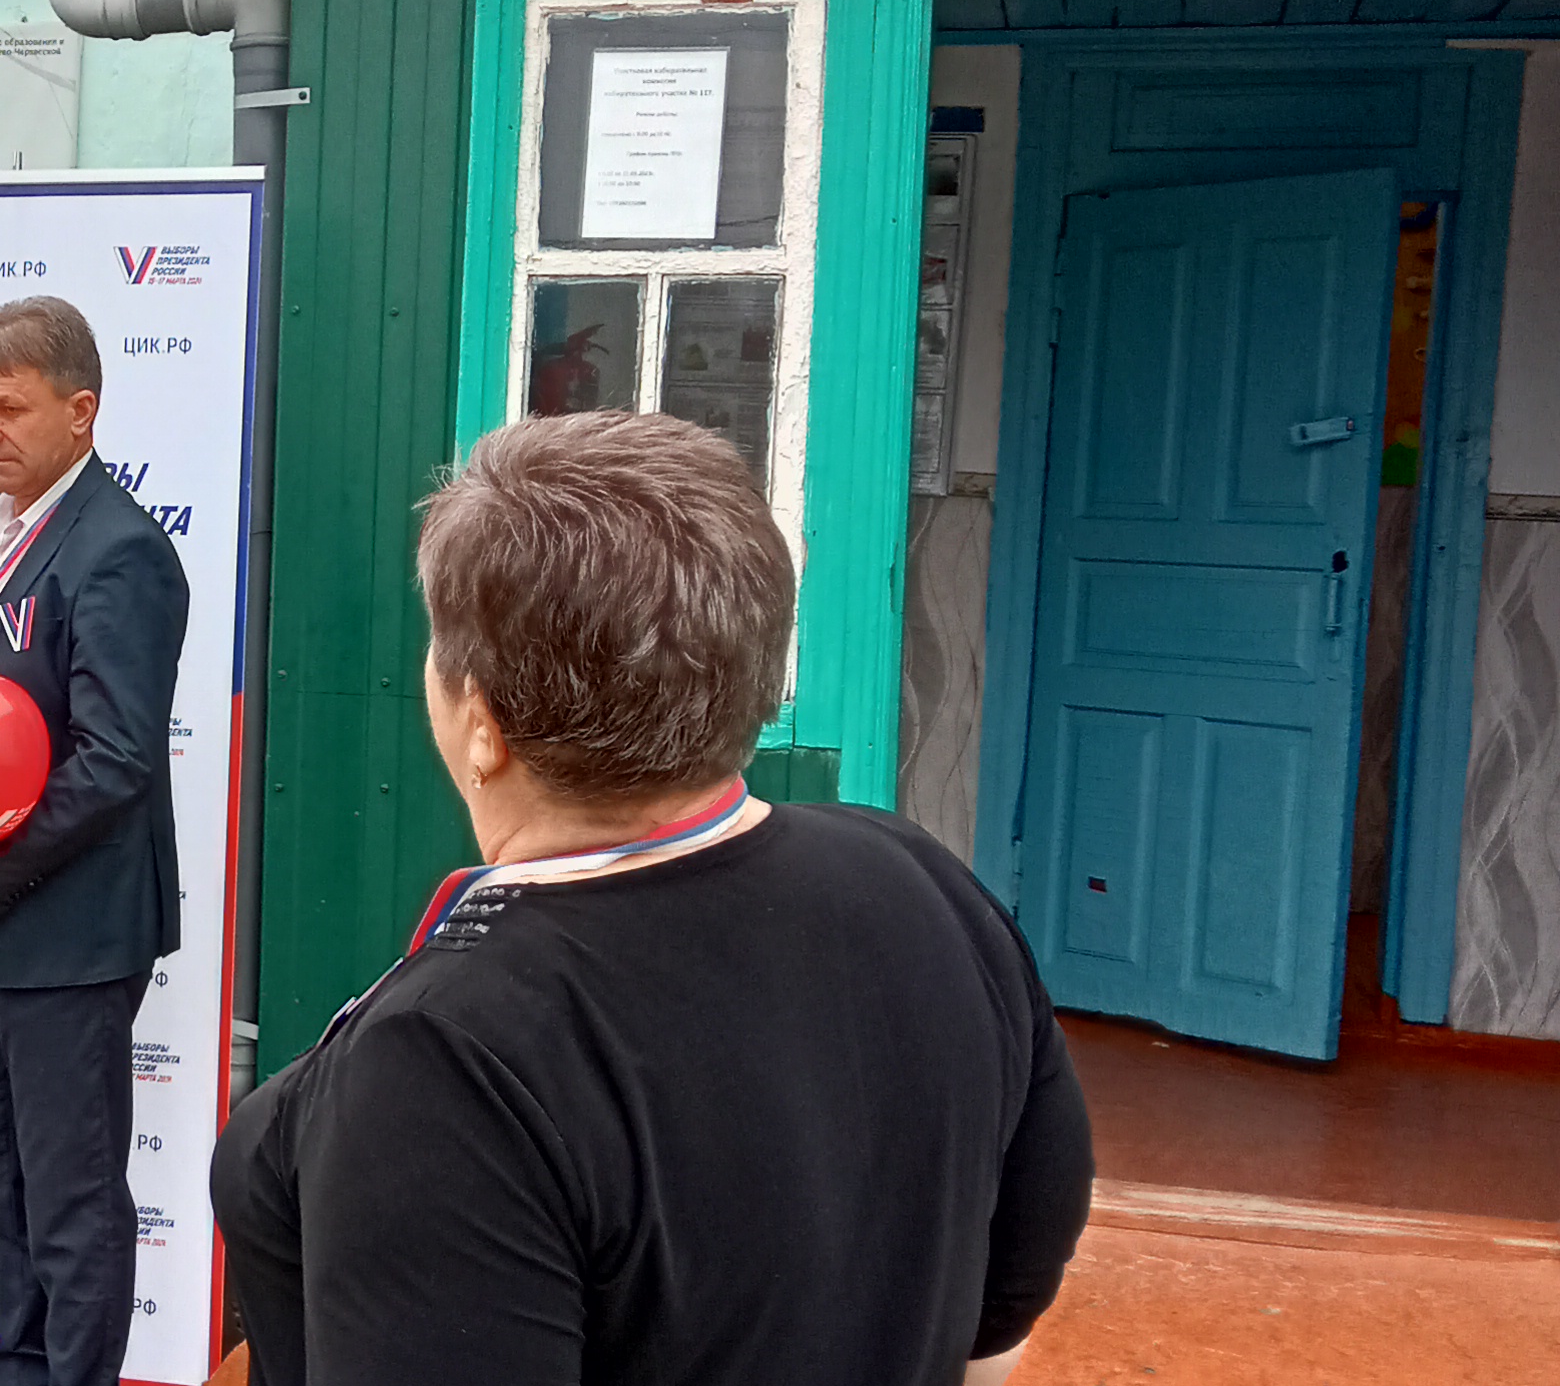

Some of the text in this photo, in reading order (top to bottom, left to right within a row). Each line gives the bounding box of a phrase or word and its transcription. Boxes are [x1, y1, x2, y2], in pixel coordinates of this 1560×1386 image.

[161, 246, 200, 254] ВЫБОРЫ
[156, 256, 210, 266] ПРЕЗИДЕНТА
[151, 267, 186, 275] РОССИИ
[124, 336, 193, 356] ЦИК.РФ
[132, 1053, 180, 1064] РЕЗИДЕНТА
